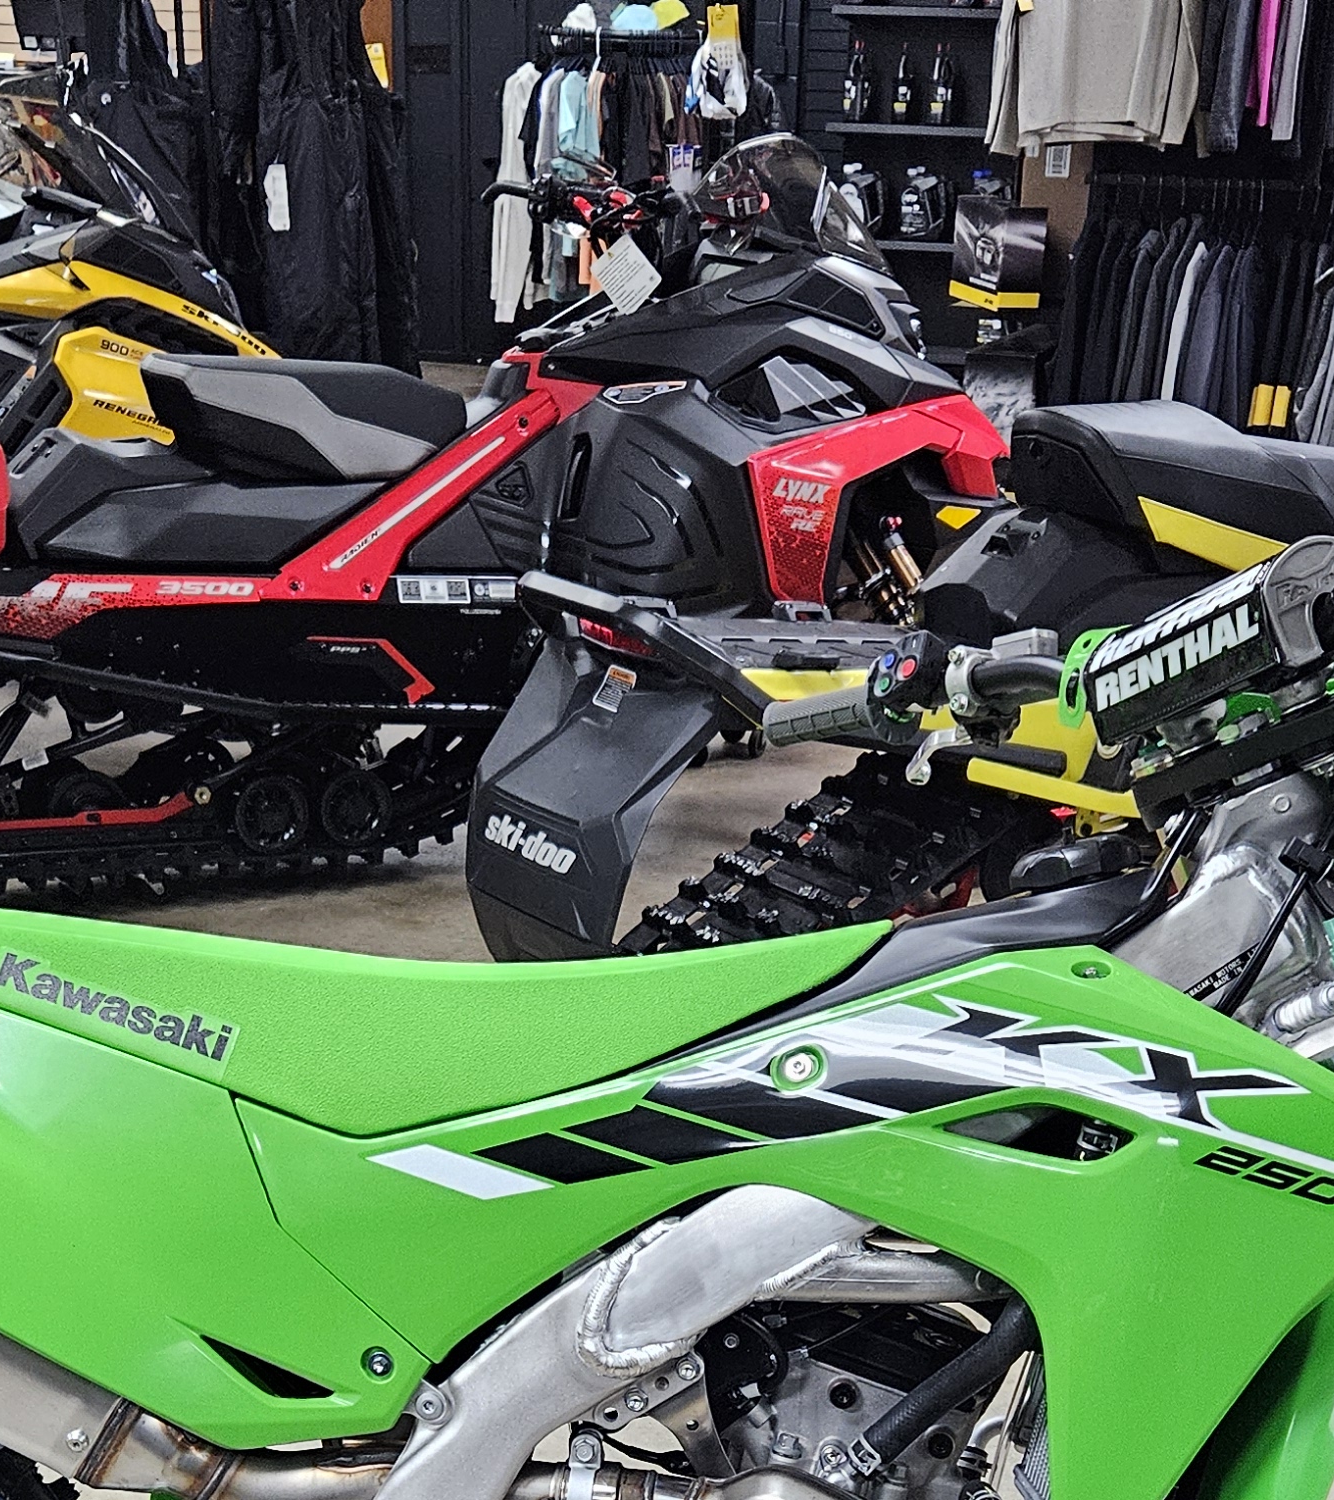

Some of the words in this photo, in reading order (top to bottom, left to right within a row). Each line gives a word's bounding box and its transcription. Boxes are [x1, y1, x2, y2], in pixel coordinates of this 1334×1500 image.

[100, 339, 129, 356] 900
[93, 400, 157, 426] RENEGA
[772, 478, 831, 503] LYNX
[157, 580, 255, 597] 3500
[1095, 602, 1260, 713] RENTHAL
[485, 814, 576, 874] ski-doo
